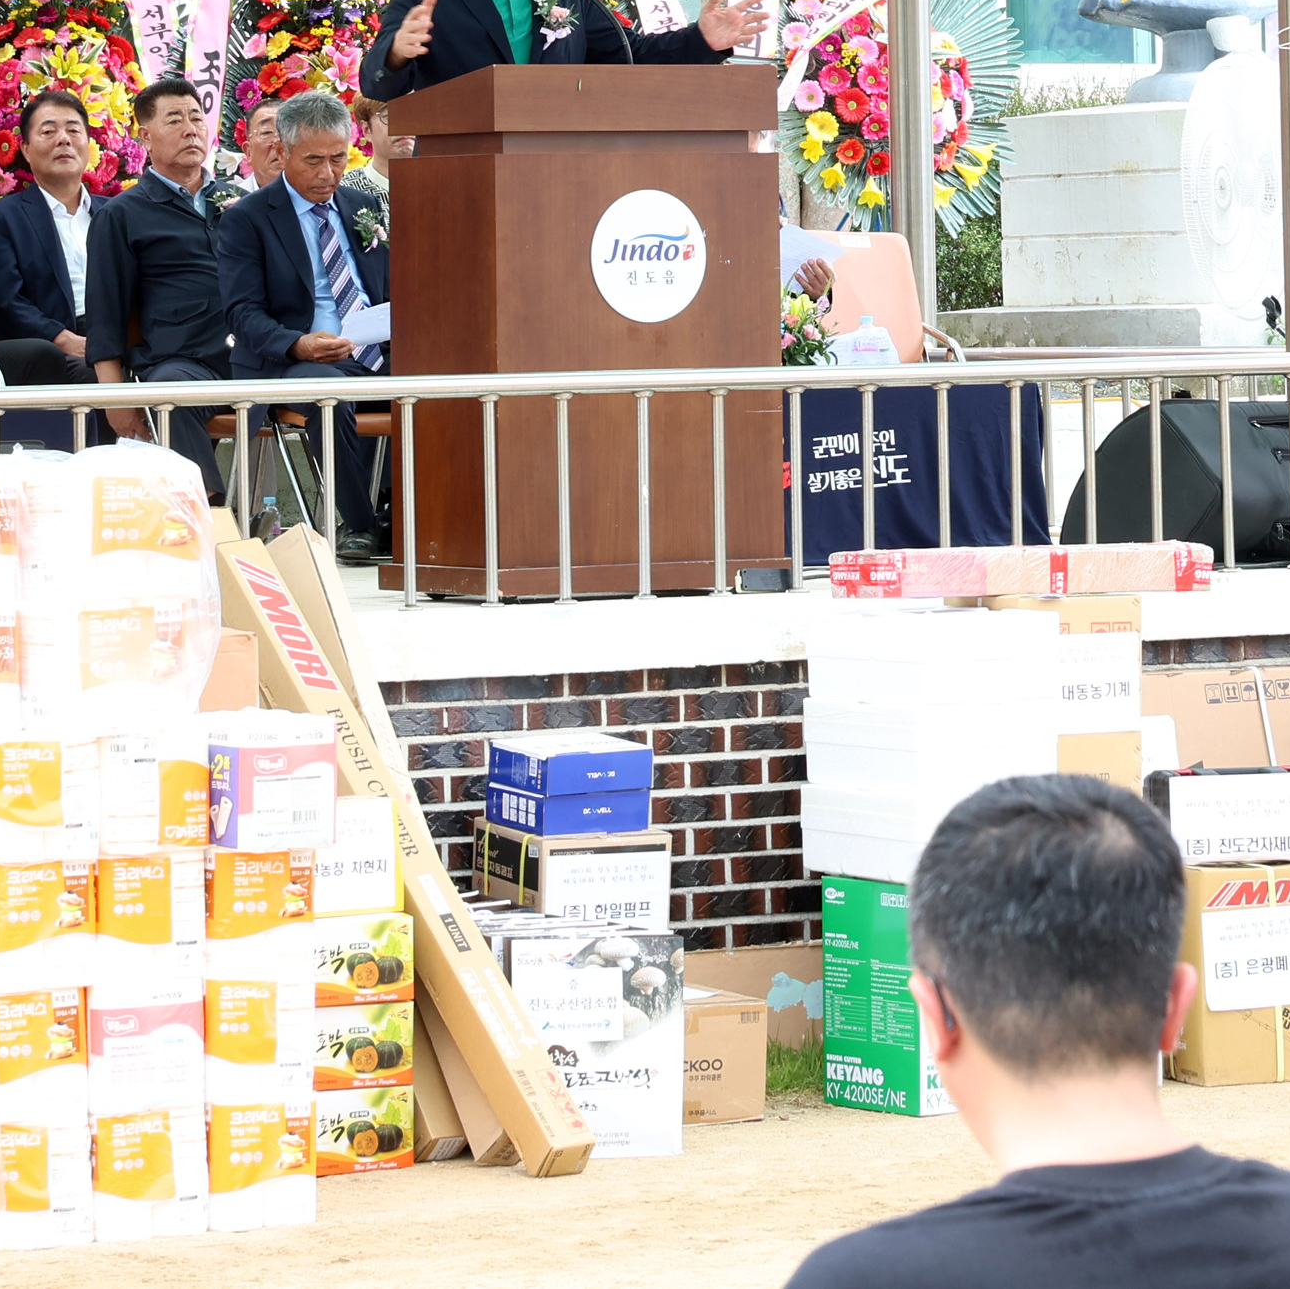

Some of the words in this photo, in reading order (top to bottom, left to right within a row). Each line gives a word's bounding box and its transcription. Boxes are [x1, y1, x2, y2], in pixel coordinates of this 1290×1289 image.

[603, 236, 681, 265] Jindo
[812, 431, 861, 459] 군민이
[806, 466, 864, 499] 살기좋은
[253, 575, 341, 694] MORI
[1061, 680, 1131, 701] 대동농기계
[327, 706, 374, 774] BRUSH
[2, 747, 56, 763] 크리넥스
[6, 868, 58, 885] 크리넥스
[113, 866, 166, 883] 크리넥스
[233, 860, 286, 876] 크리넥스
[351, 859, 388, 875] 차현지
[476, 856, 514, 880] 한자동펌프
[594, 900, 652, 920] 한일펌프
[527, 995, 619, 1012] 진도군산림조합
[826, 1062, 884, 1087] KEYANG
[826, 1081, 907, 1109] KY-4200SE/NE
[229, 1109, 281, 1127] 크리넥스
